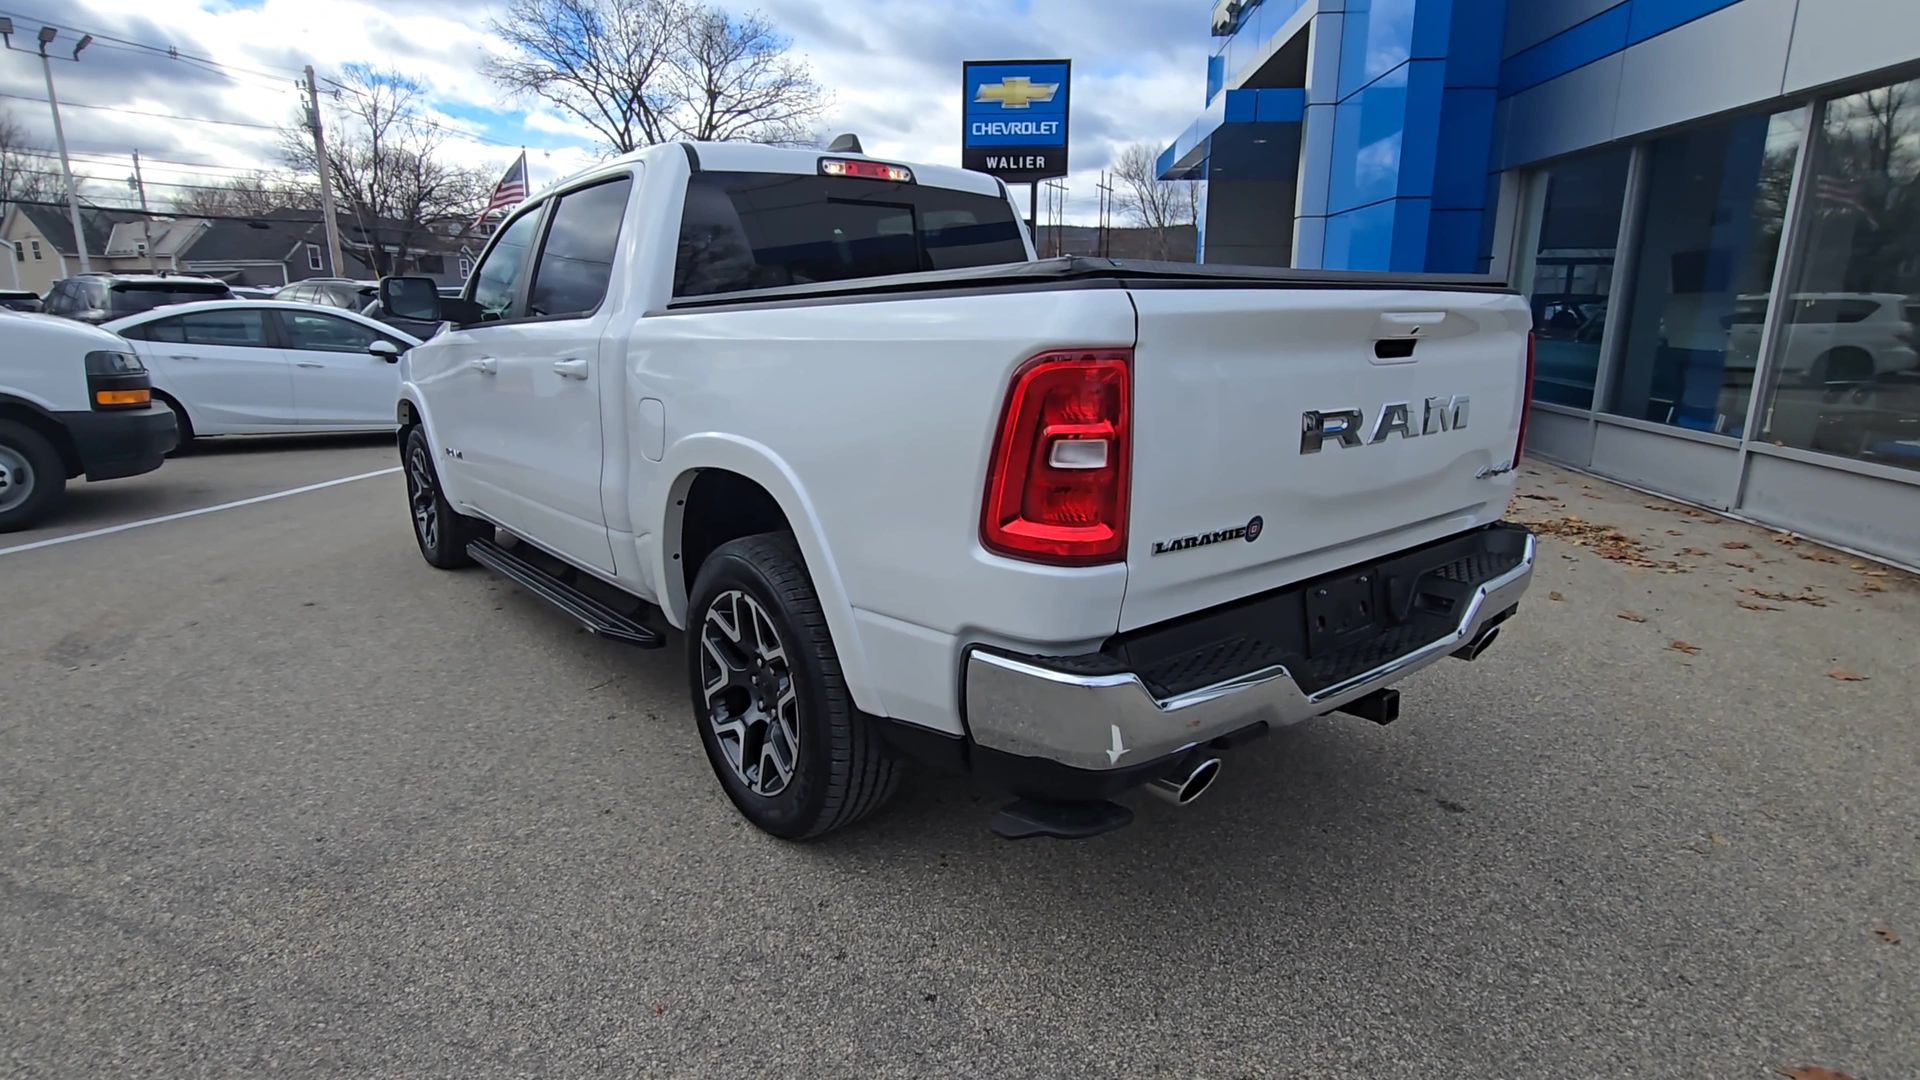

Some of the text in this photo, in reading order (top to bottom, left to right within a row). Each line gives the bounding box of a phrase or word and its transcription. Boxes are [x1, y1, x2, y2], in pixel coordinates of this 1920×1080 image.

[972, 121, 1059, 135] CHEVROLET
[986, 156, 1045, 169] WALIER
[1299, 394, 1470, 455] RAM
[1152, 526, 1247, 556] LARAMIE
